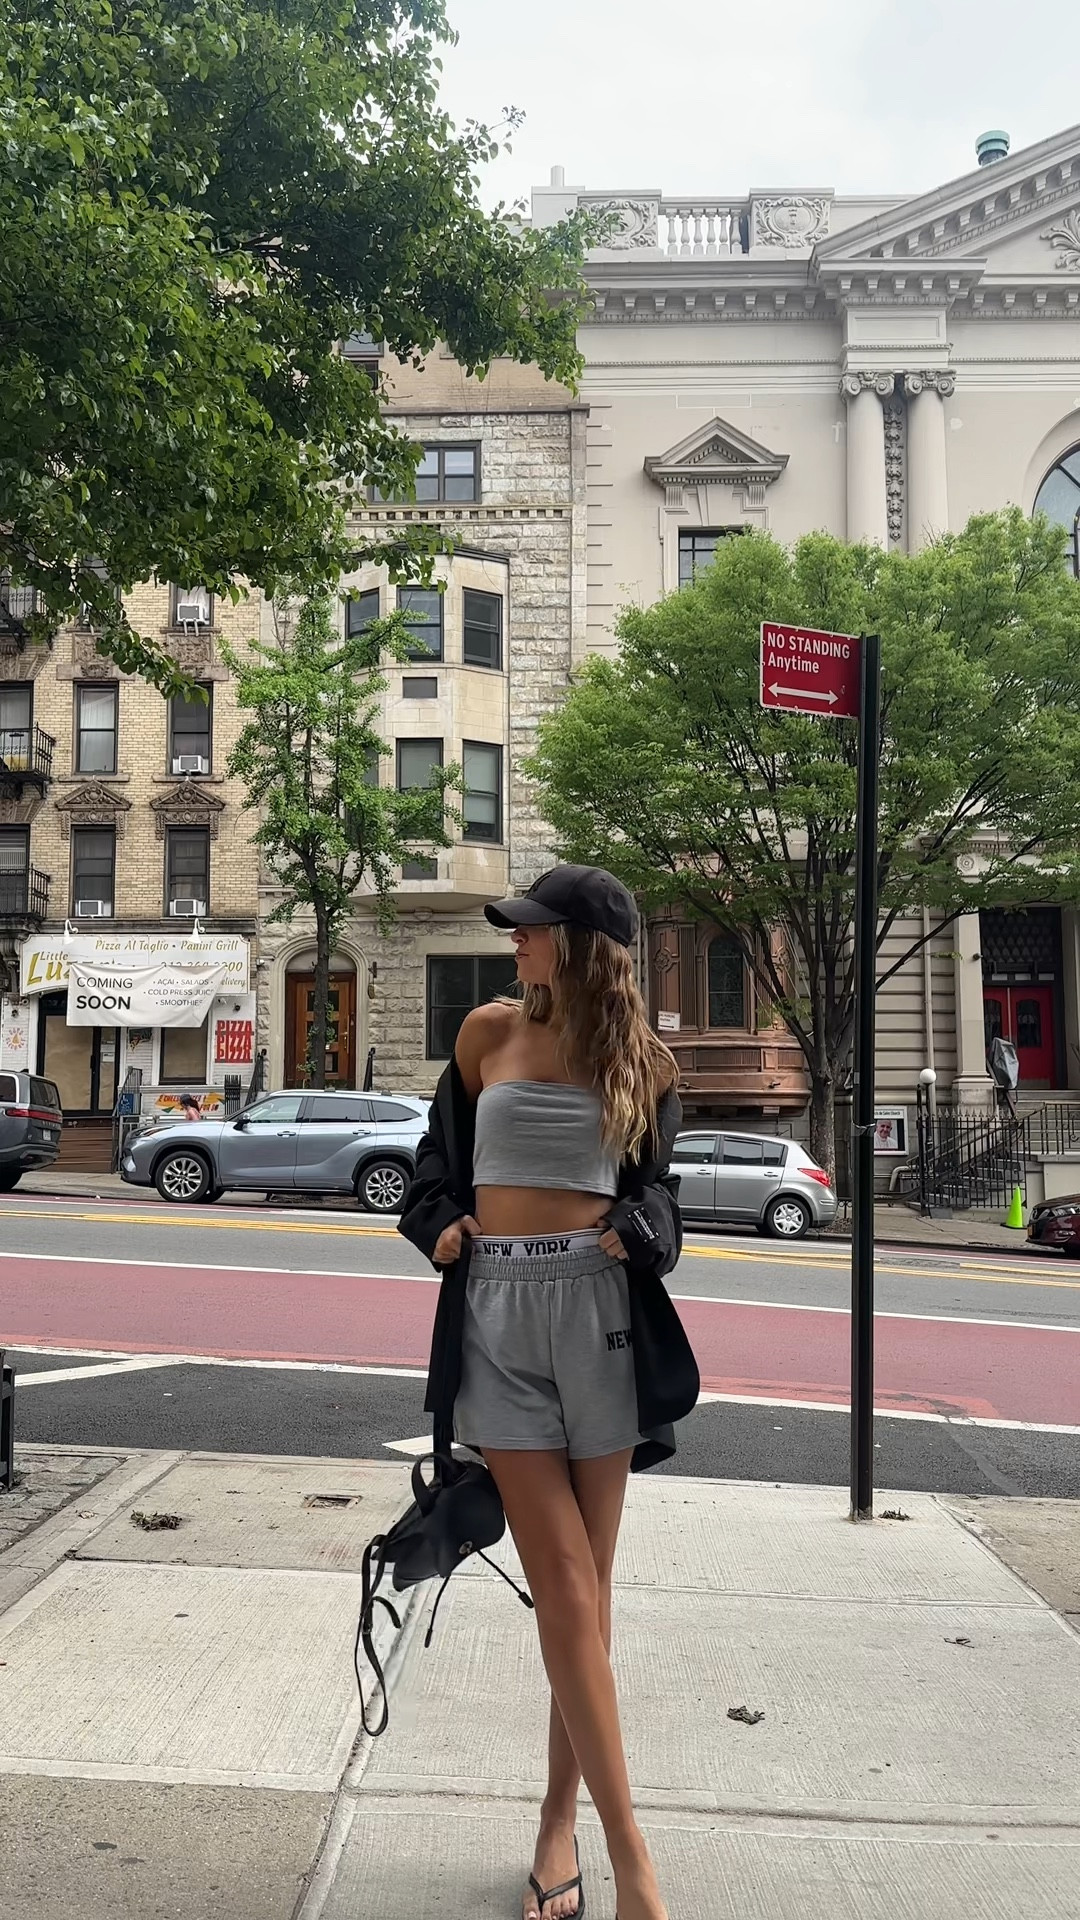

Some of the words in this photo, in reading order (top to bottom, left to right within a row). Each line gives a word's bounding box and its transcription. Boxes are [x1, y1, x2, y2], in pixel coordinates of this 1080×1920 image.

[767, 631, 785, 649] NO
[789, 635, 850, 659] STANDING
[768, 651, 820, 673] Anytime
[95, 940, 121, 950] Pizza
[124, 940, 136, 950] Al
[139, 940, 169, 954] Taglio
[180, 940, 212, 950] Panini
[216, 940, 238, 950] Grill
[39, 951, 69, 961] Little
[76, 977, 133, 989] COMING
[221, 977, 246, 987] elivery
[76, 995, 131, 1010] SOON
[217, 1020, 252, 1034] PIZZA
[217, 1034, 252, 1047] PIZZA
[216, 1047, 251, 1063] PIZZA
[482, 1242, 513, 1256] NEW
[523, 1239, 571, 1256] YORK
